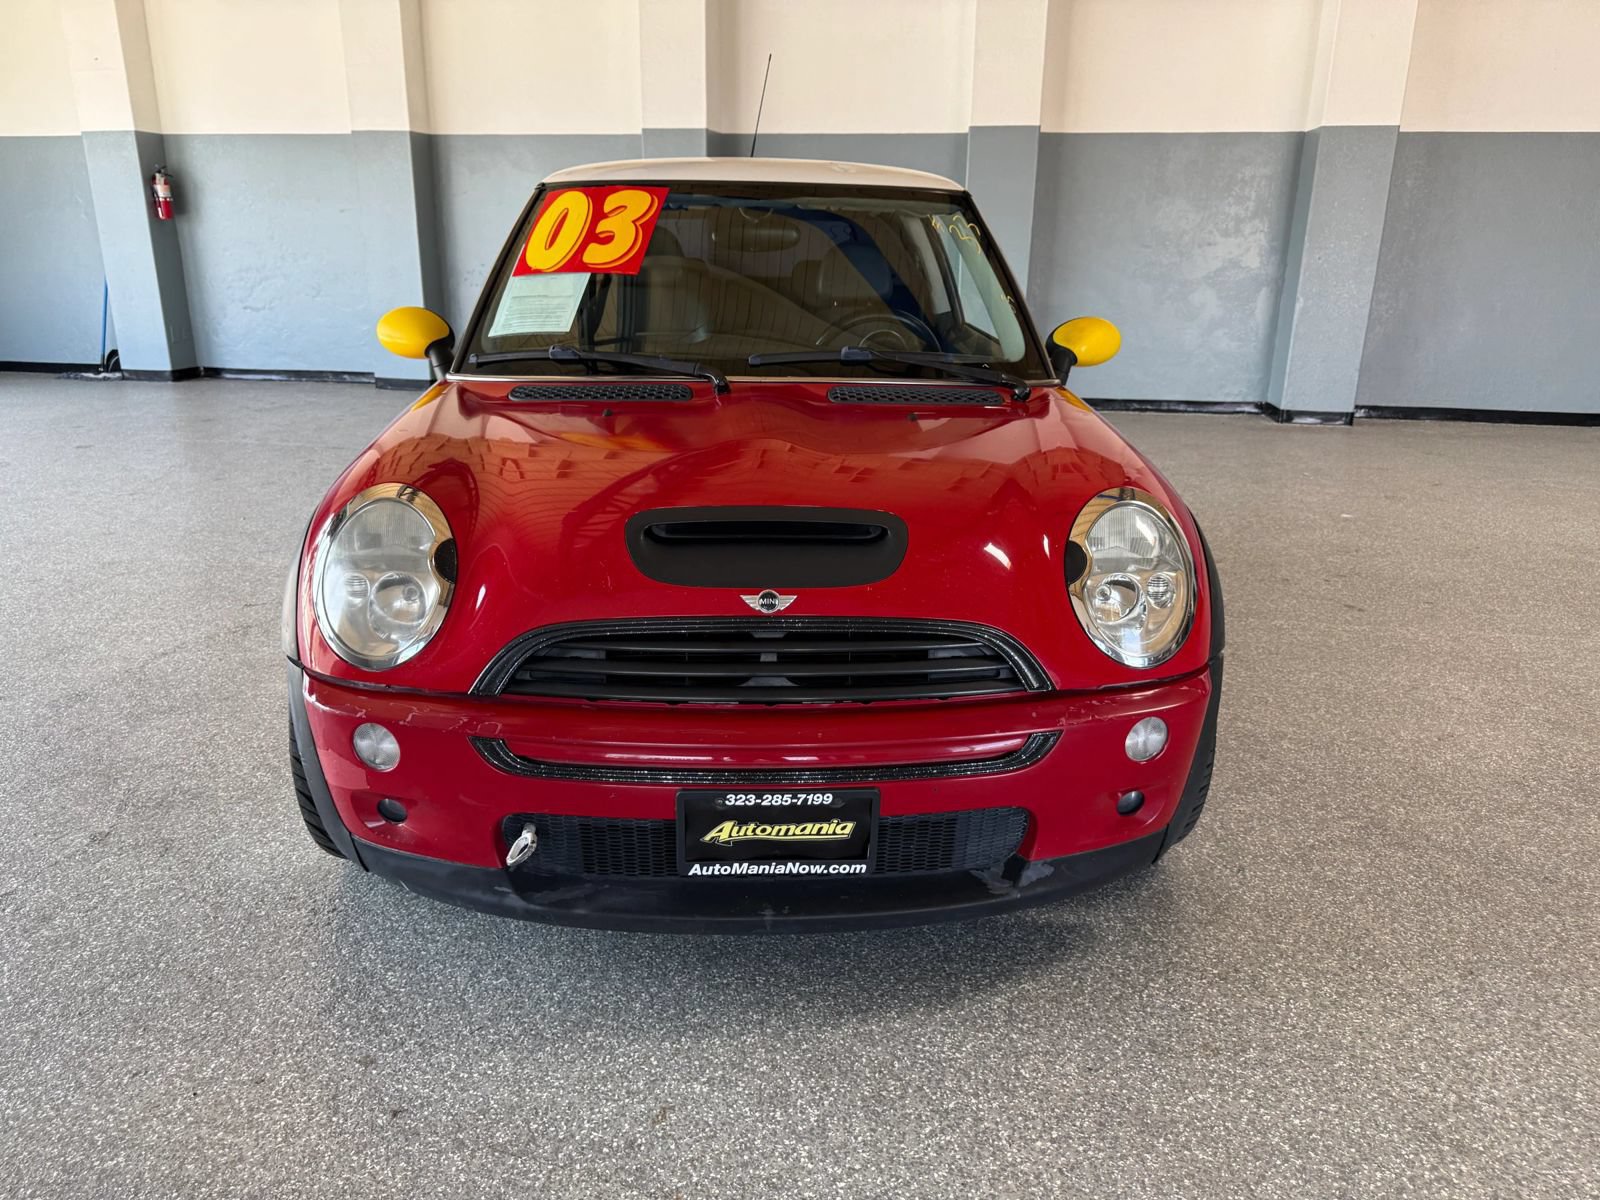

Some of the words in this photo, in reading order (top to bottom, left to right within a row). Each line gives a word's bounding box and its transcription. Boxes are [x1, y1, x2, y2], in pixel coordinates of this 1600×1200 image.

[525, 189, 658, 272] 03
[759, 597, 779, 605] MINI
[725, 793, 833, 806] 323-285-7199
[702, 818, 856, 843] Automania
[688, 862, 867, 876] AutoManiaNow.com
